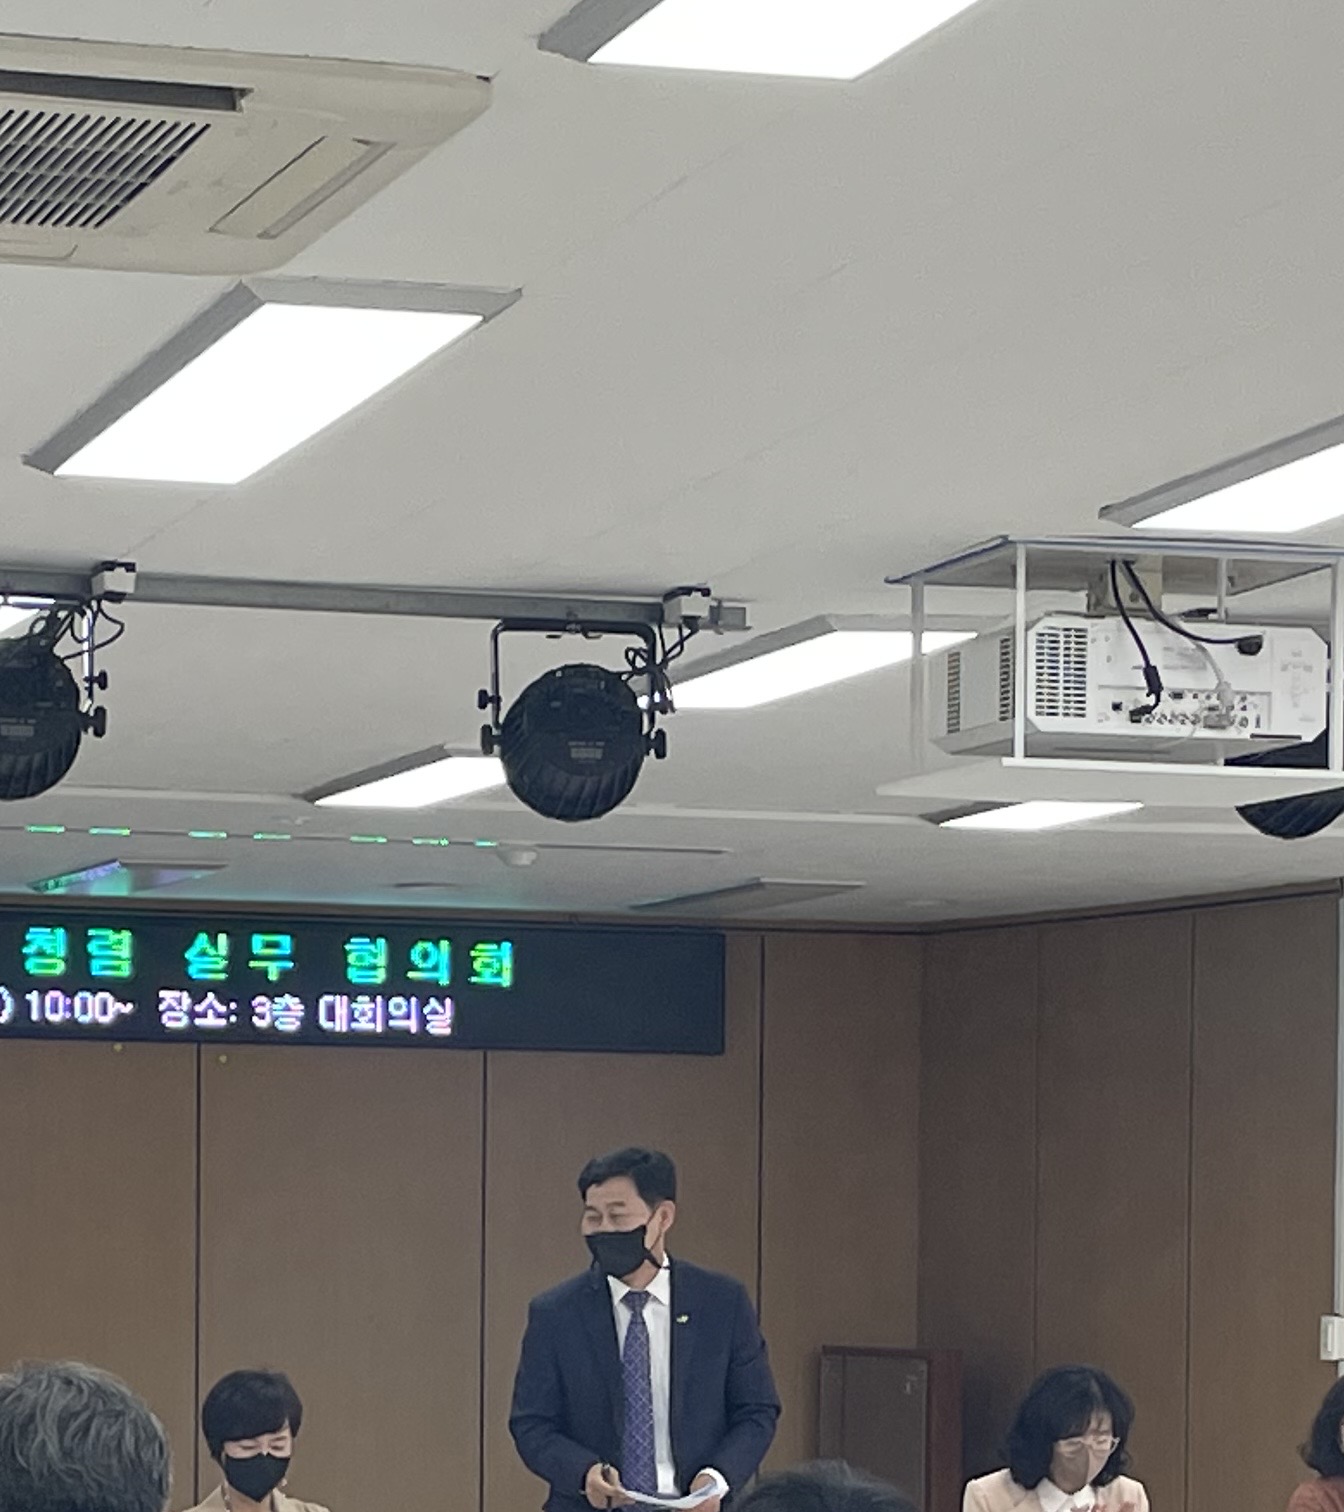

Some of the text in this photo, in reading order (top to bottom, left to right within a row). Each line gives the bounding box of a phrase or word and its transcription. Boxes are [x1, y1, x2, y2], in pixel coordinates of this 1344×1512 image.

[21, 926, 133, 978] 청렴
[184, 931, 295, 982] 실무
[344, 936, 514, 989] 협의회
[24, 988, 135, 1024] 10:00~
[157, 989, 238, 1029] 장소:
[251, 993, 305, 1032] 3층
[318, 994, 454, 1036] 대회의실
